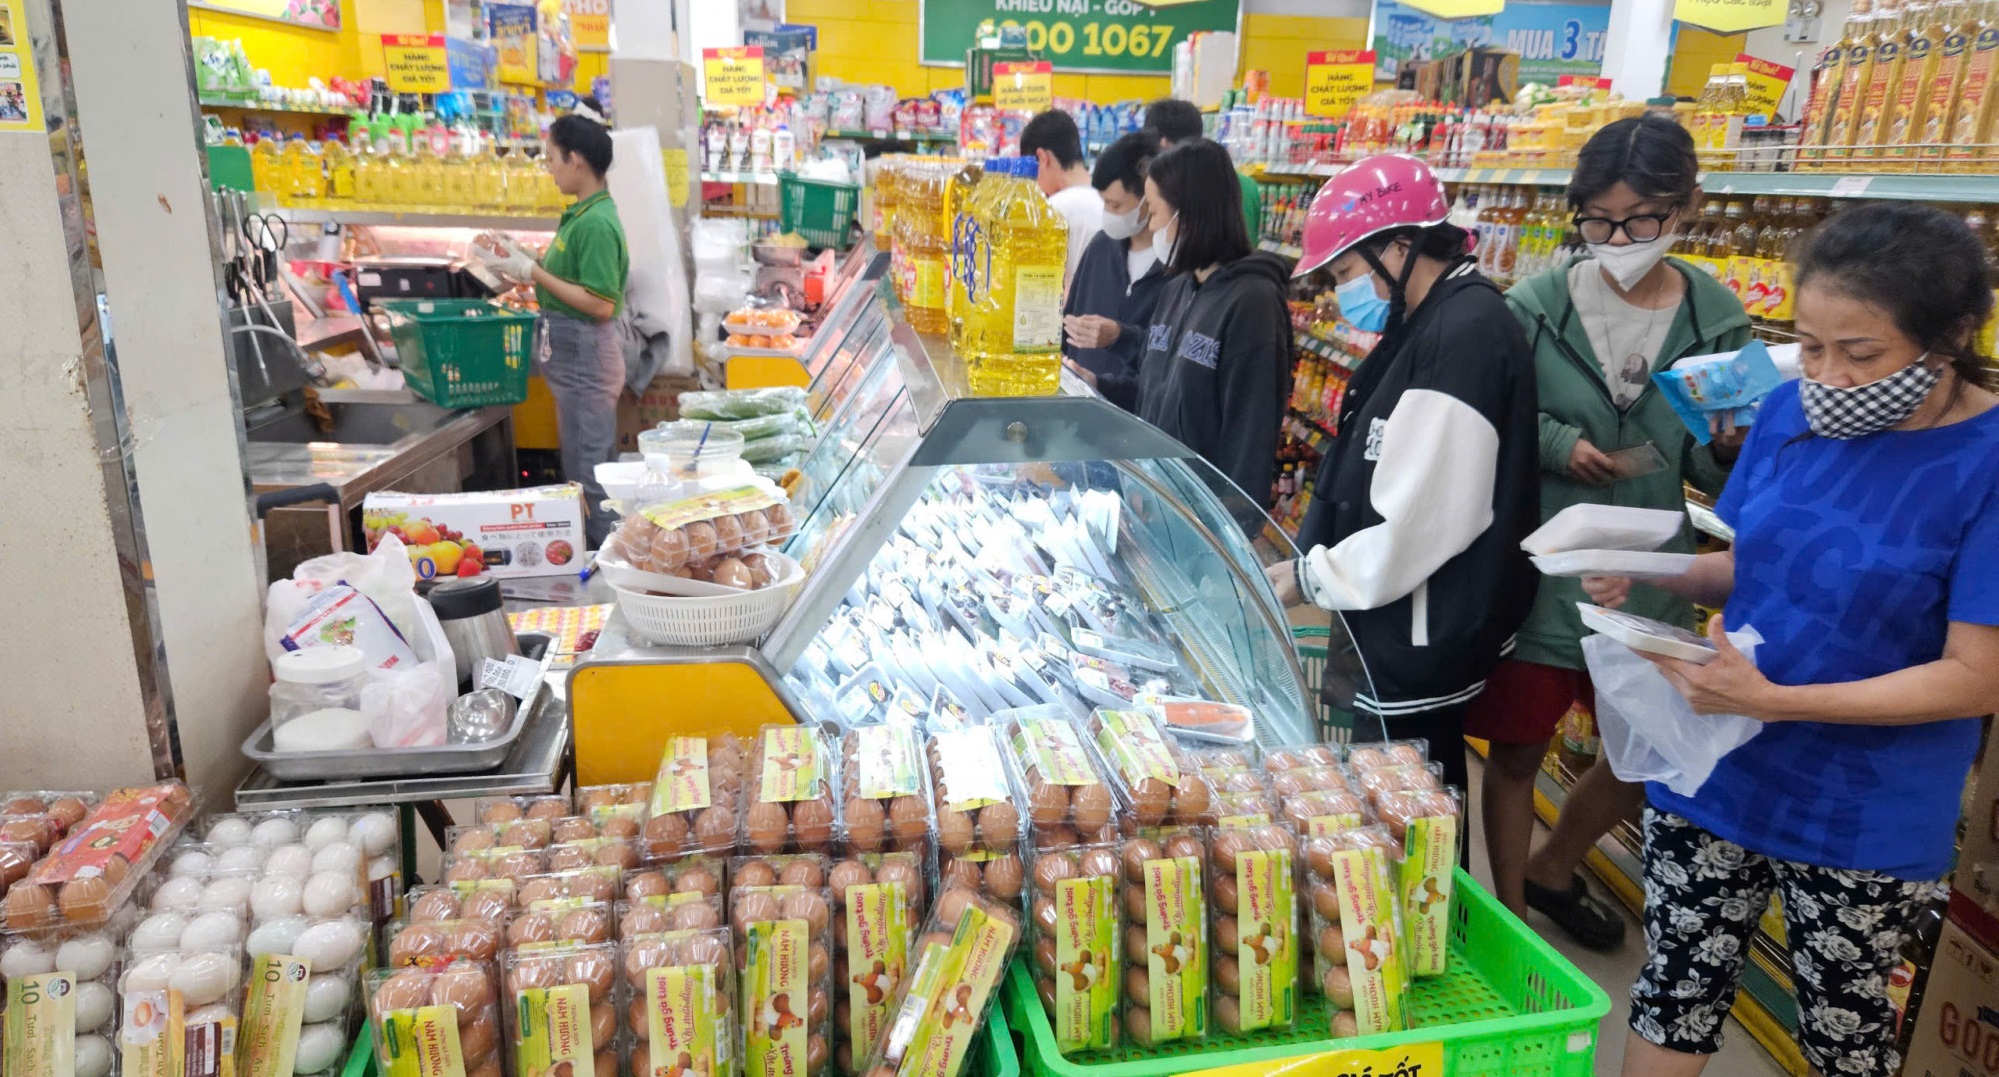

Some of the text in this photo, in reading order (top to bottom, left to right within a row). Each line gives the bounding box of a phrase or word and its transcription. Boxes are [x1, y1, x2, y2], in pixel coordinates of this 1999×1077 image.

[1083, 22, 1175, 57] 1067
[1505, 28, 1555, 60] MUA
[1561, 18, 1581, 61] 3
[1360, 182, 1403, 205] MY BIKE
[510, 502, 535, 520] PT
[264, 960, 282, 983] 10
[20, 980, 40, 1005] 10
